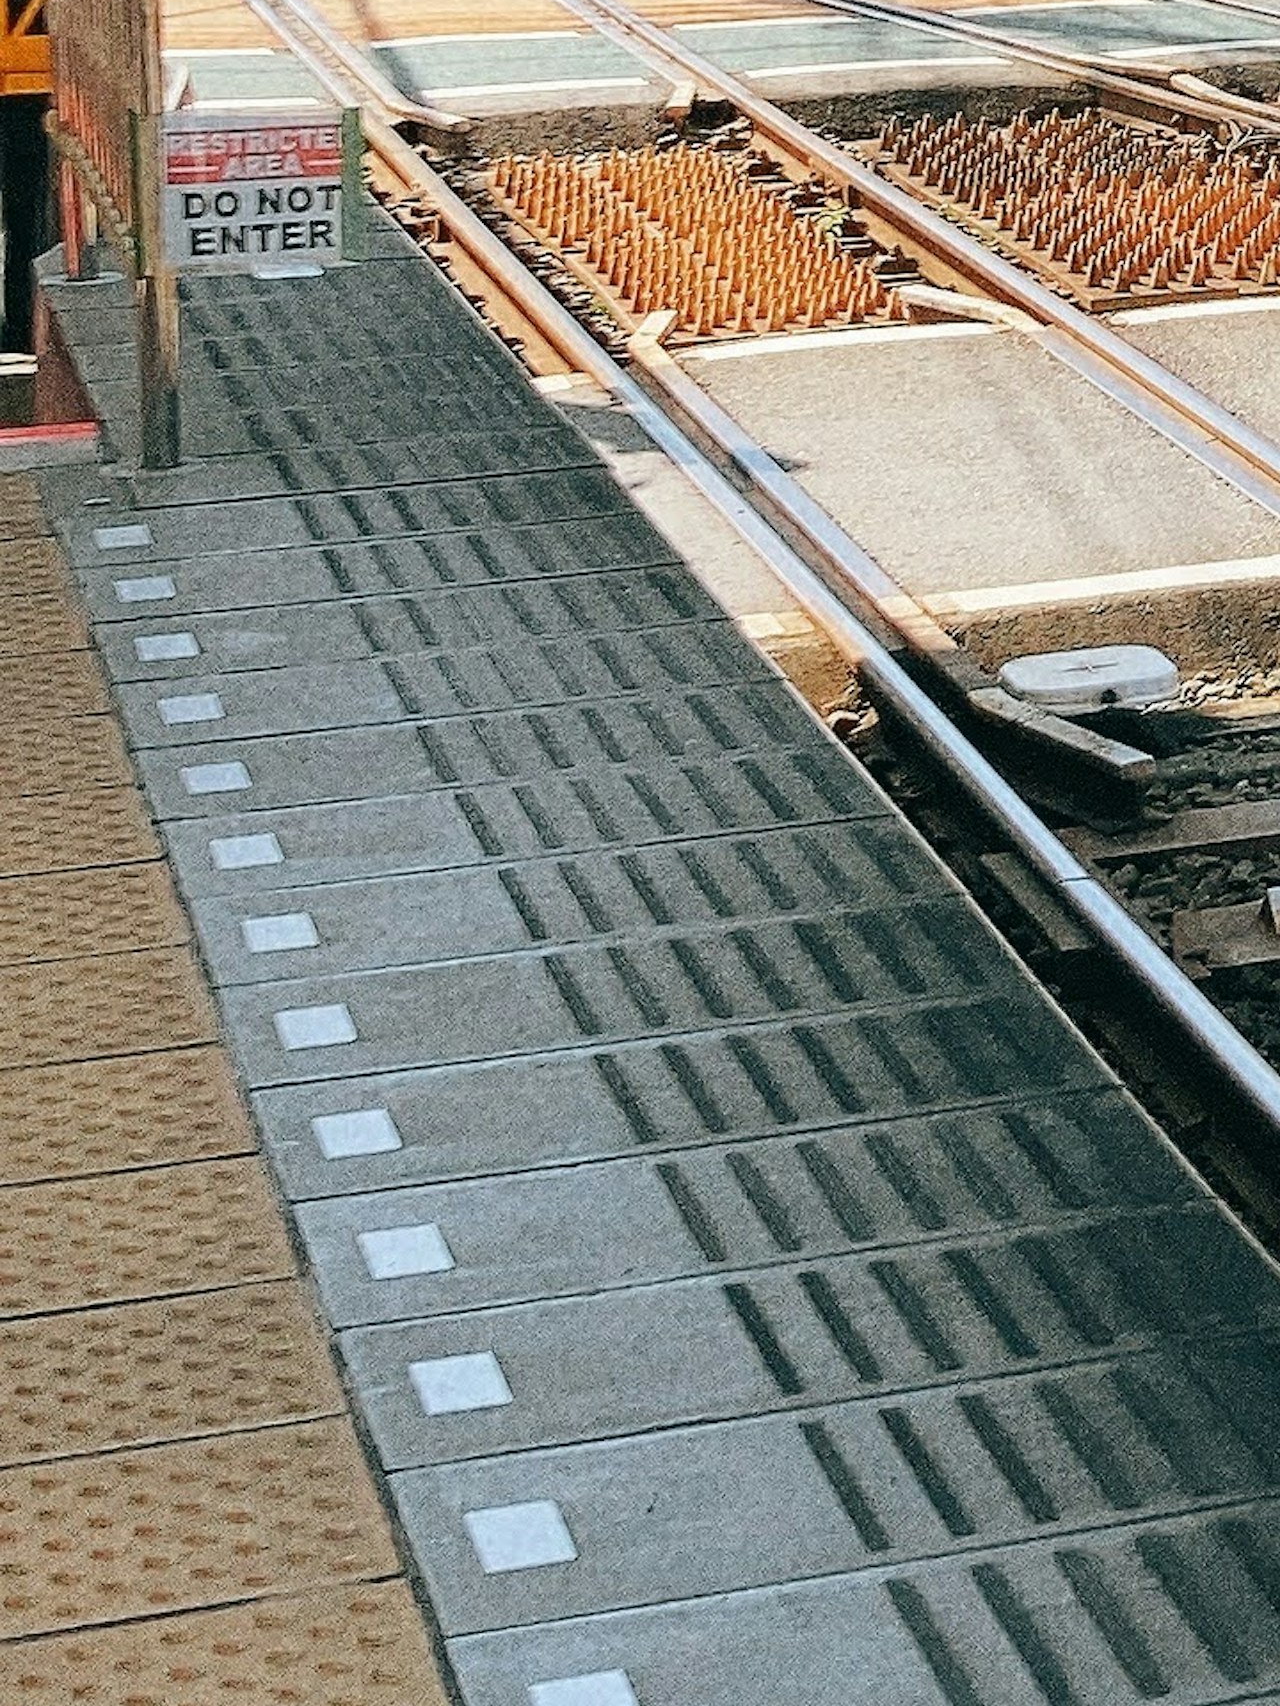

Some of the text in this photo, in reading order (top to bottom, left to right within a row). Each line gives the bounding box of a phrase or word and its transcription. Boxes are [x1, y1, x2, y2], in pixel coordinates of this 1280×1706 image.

[168, 127, 342, 154] RESTRICTE
[222, 152, 304, 180] AREA
[181, 185, 342, 220] DO NOT
[190, 219, 336, 256] ENTER
